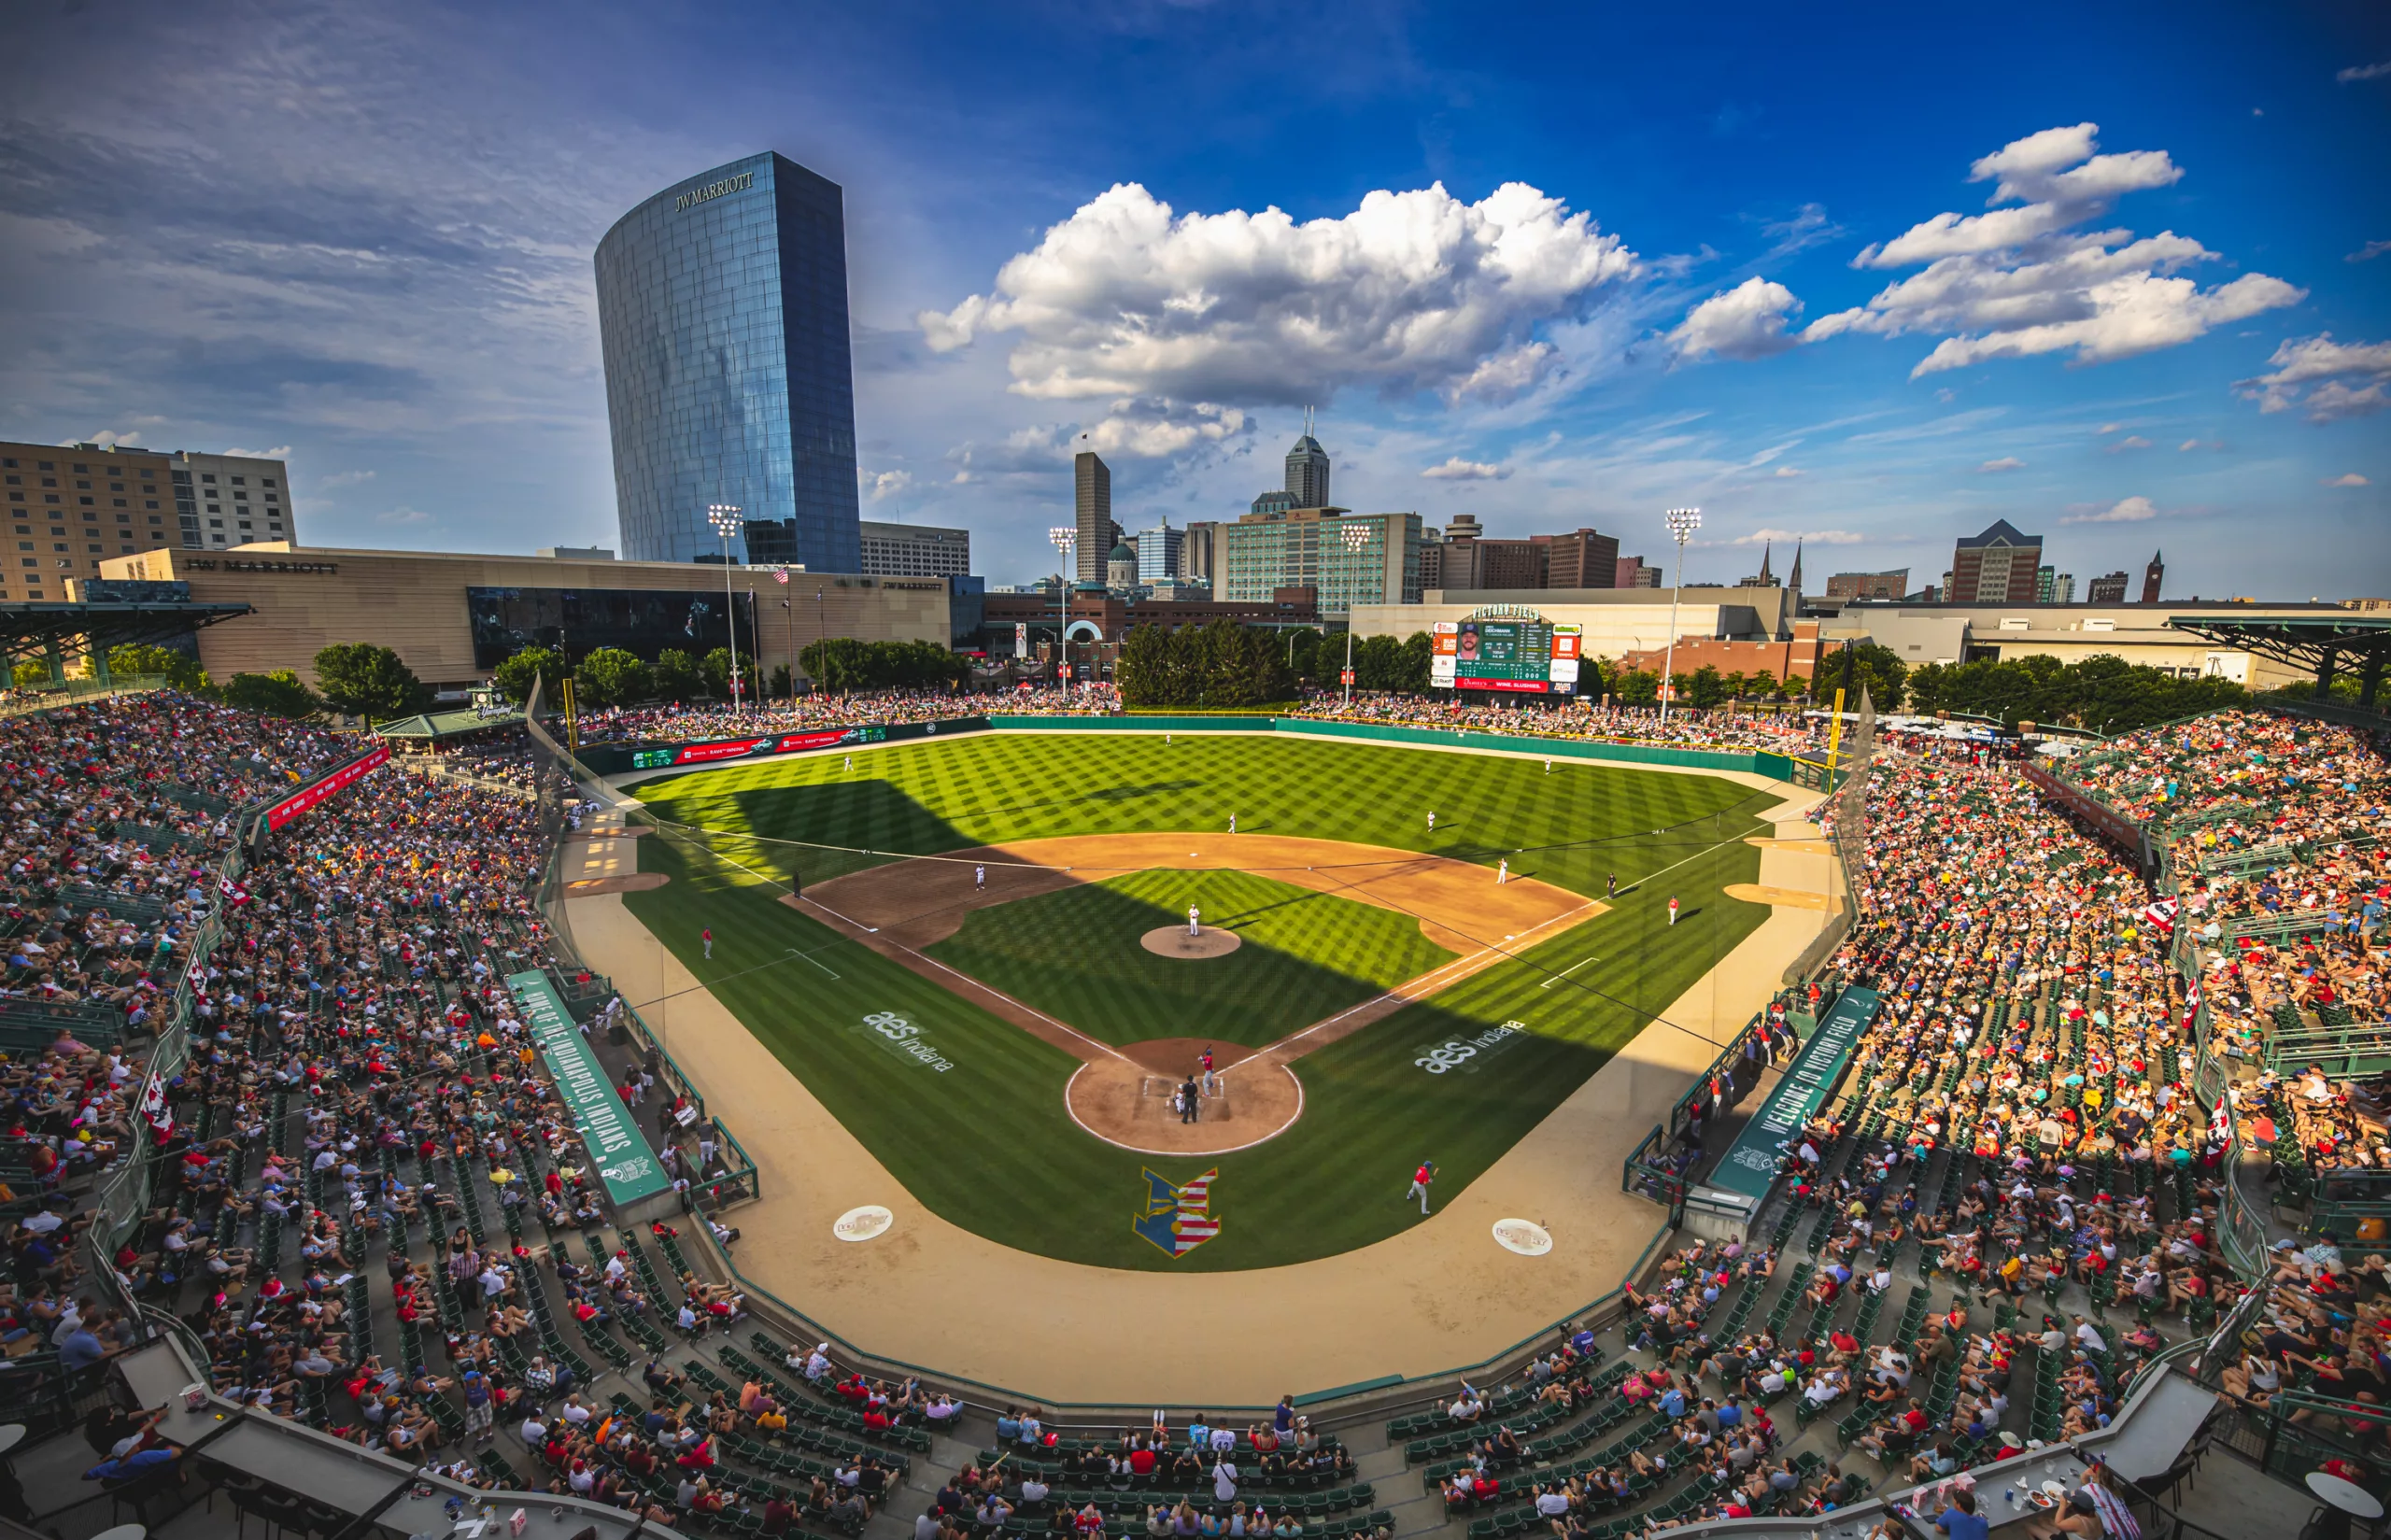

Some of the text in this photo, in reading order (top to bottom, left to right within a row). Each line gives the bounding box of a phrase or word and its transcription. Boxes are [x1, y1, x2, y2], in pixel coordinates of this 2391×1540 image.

[676, 172, 754, 212] JW MARRIOTT
[183, 558, 338, 574] JW MARRIOTT
[884, 582, 942, 590] JW MARRIOTT
[1472, 603, 1540, 620] VICTORY FIELD
[477, 702, 514, 720] Yuengling
[863, 1011, 955, 1072] aes Indiana
[1414, 1020, 1525, 1074] aes Indiana
[524, 991, 631, 1152] HOME OF THE INDIANAPOLIS INDIANS
[1761, 1015, 1858, 1135] WELCOME TO VICTORY FIELD
